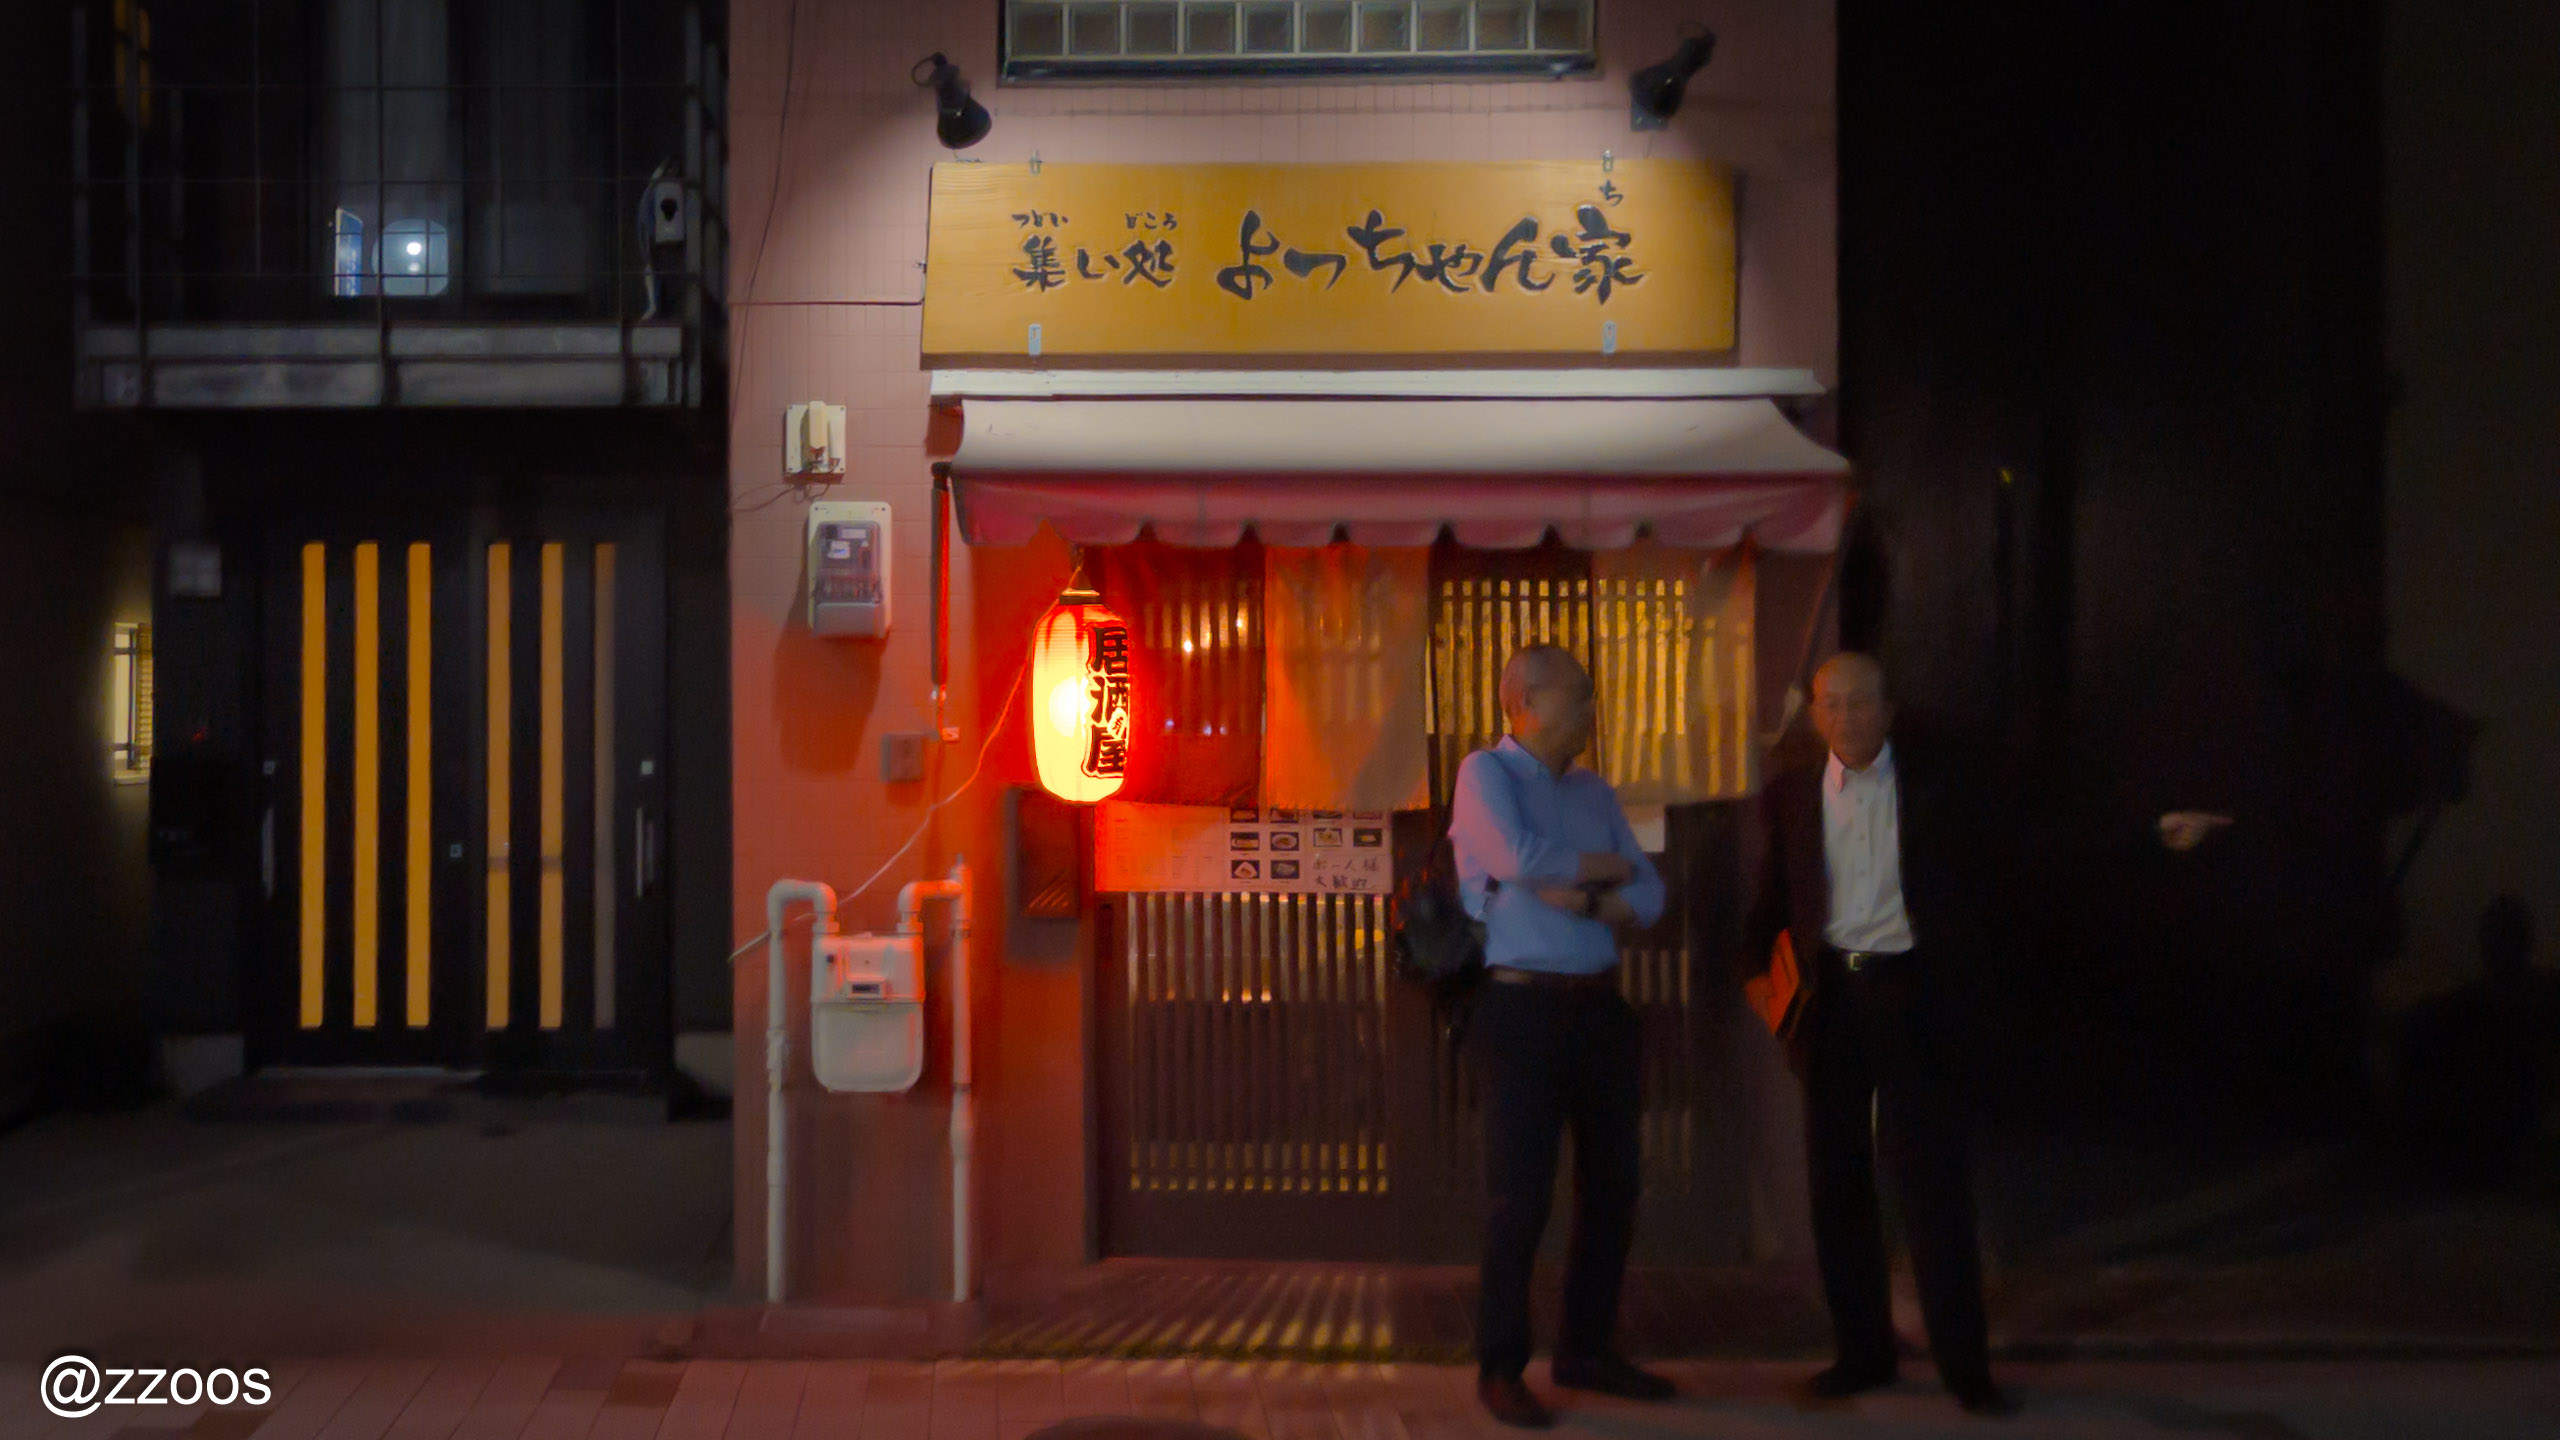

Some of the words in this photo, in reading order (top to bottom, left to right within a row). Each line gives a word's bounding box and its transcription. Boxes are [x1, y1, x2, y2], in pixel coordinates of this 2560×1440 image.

[1012, 234, 1175, 292] 集い処
[1216, 205, 1645, 305] よっちゃん家
[1125, 211, 1178, 230] どころ
[1087, 627, 1129, 773] 居酒屋
